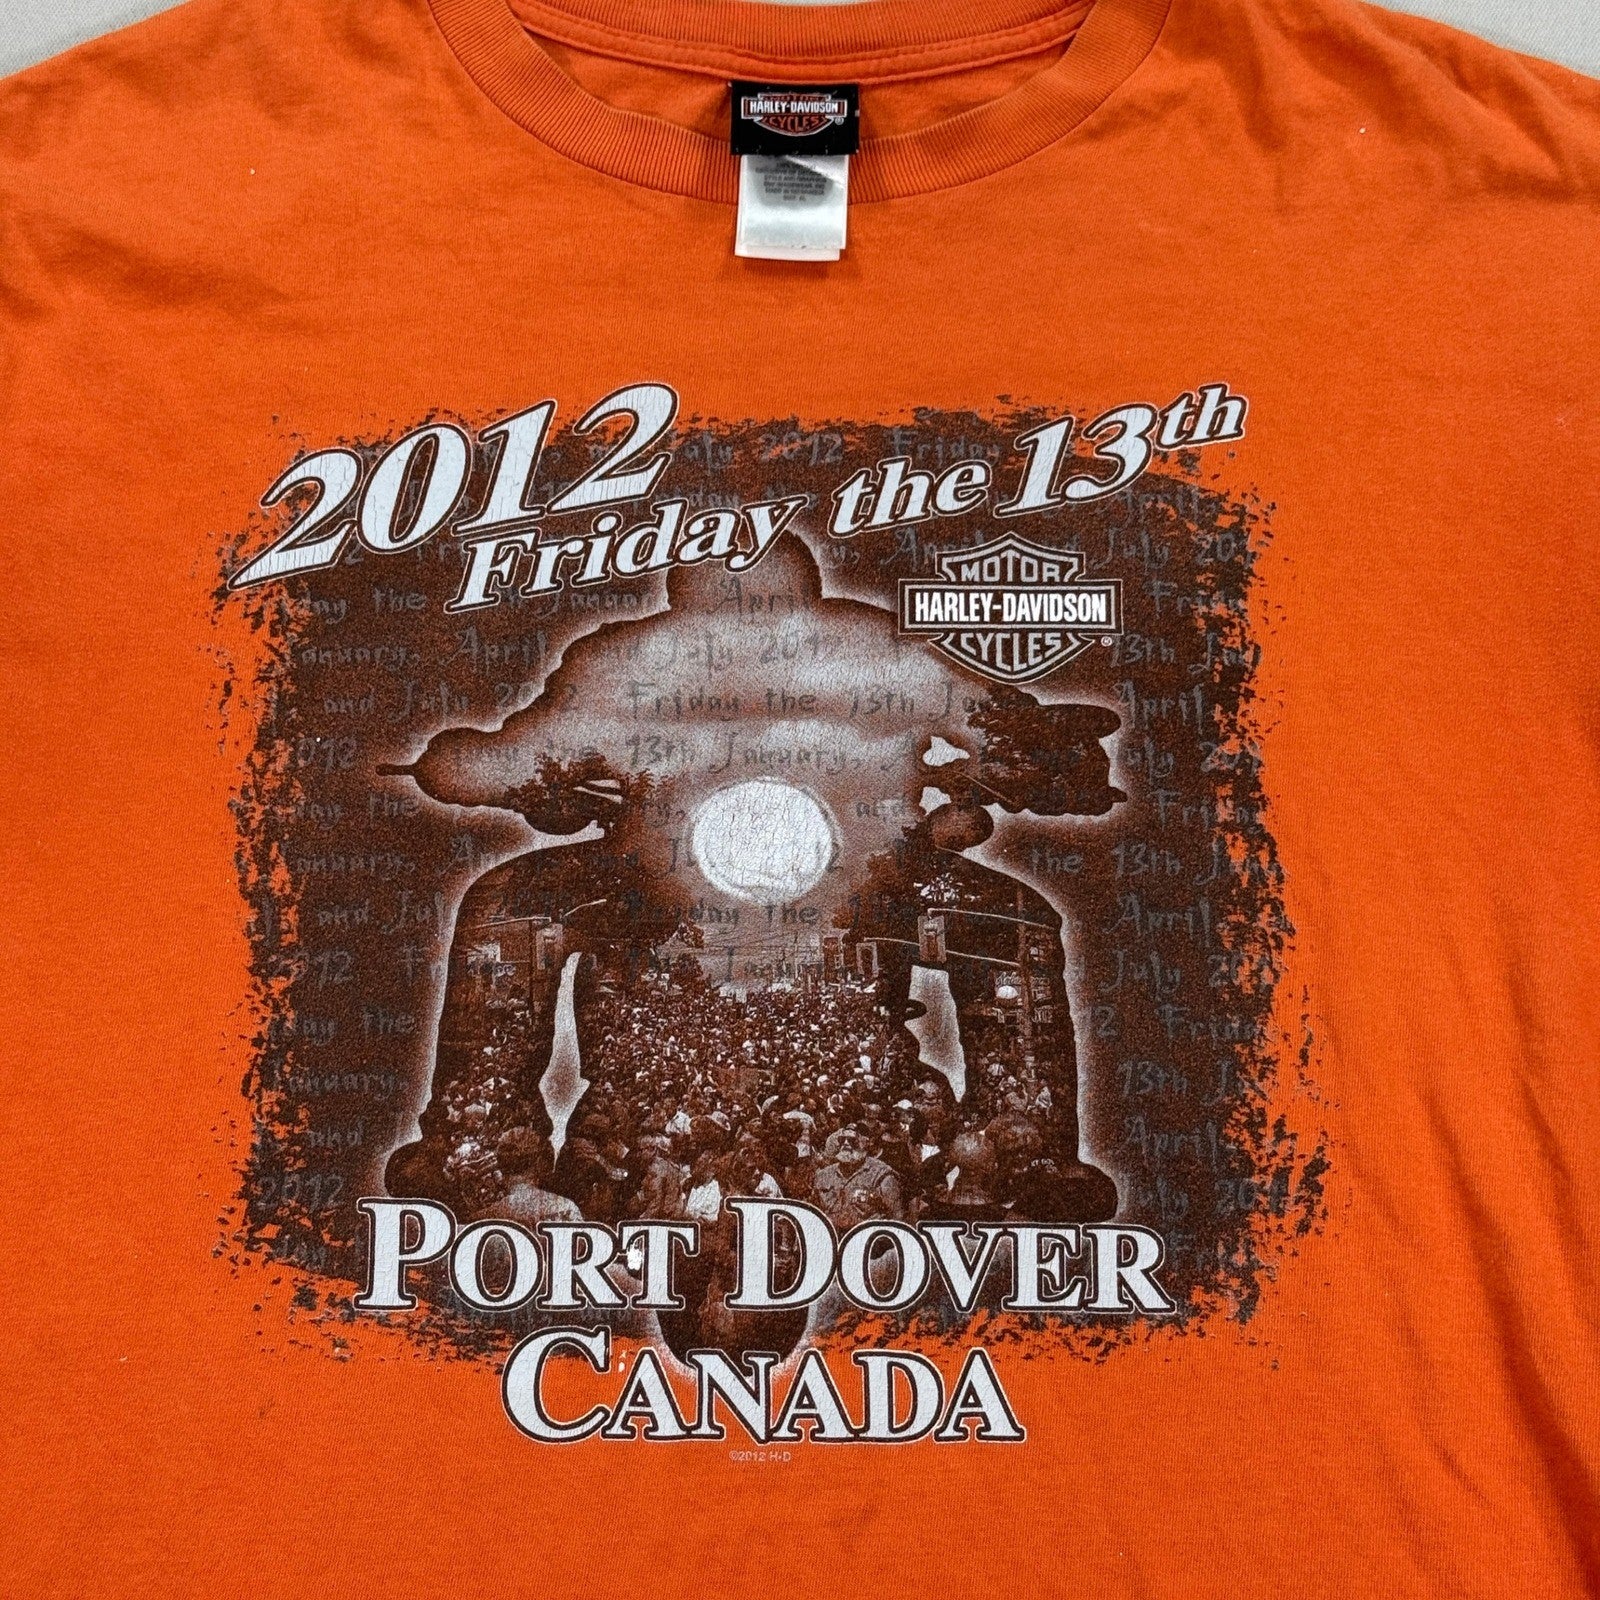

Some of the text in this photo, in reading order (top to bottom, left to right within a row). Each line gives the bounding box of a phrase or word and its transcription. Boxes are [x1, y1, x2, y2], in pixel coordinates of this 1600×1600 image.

[750, 101, 838, 114] HARLEY-DAVIDSON
[769, 116, 820, 132] CYCLES
[229, 382, 679, 590] 2012
[445, 382, 1247, 613] Friday the 13th
[960, 549, 1062, 583] MOTOR
[372, 585, 428, 614] the
[914, 591, 1107, 623] HARLEY-DAVIDSON
[960, 633, 1062, 672] CYCLES
[627, 680, 742, 722] Friday
[766, 688, 817, 714] the
[1030, 848, 1084, 878] the
[353, 1198, 1177, 1314] PORT DOVER
[501, 1325, 1026, 1446] CANADA
